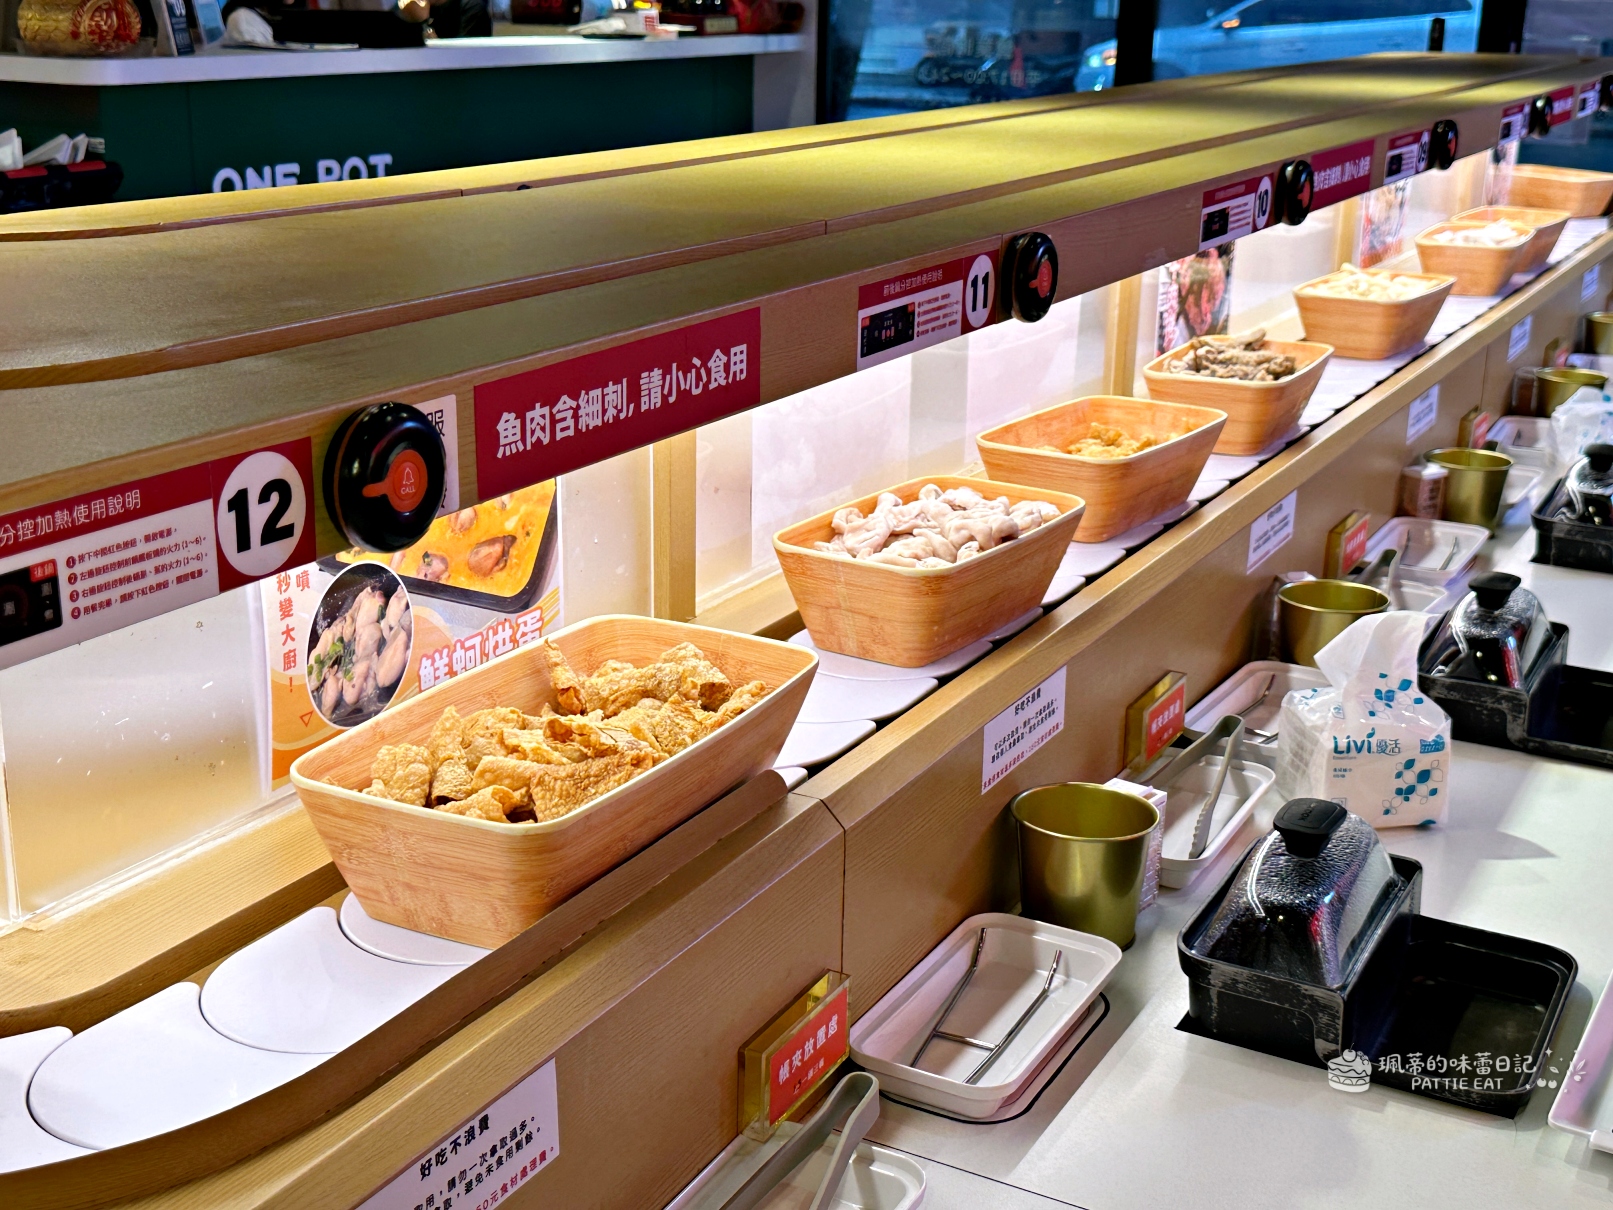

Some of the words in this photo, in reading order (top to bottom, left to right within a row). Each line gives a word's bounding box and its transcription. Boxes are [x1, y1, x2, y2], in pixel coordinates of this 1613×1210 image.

[212, 162, 300, 193] ONE
[317, 153, 393, 183] POT
[1257, 188, 1269, 218] 10
[970, 271, 990, 313] 11
[0, 489, 141, 547] 分控加熱使用說明
[227, 478, 295, 554] 12
[400, 485, 416, 495] CALL
[419, 607, 544, 692] 鮮蚵烘蛋
[420, 1114, 490, 1181] 好吃不浪費
[434, 1127, 541, 1210] 取，避免未食用剩餘。
